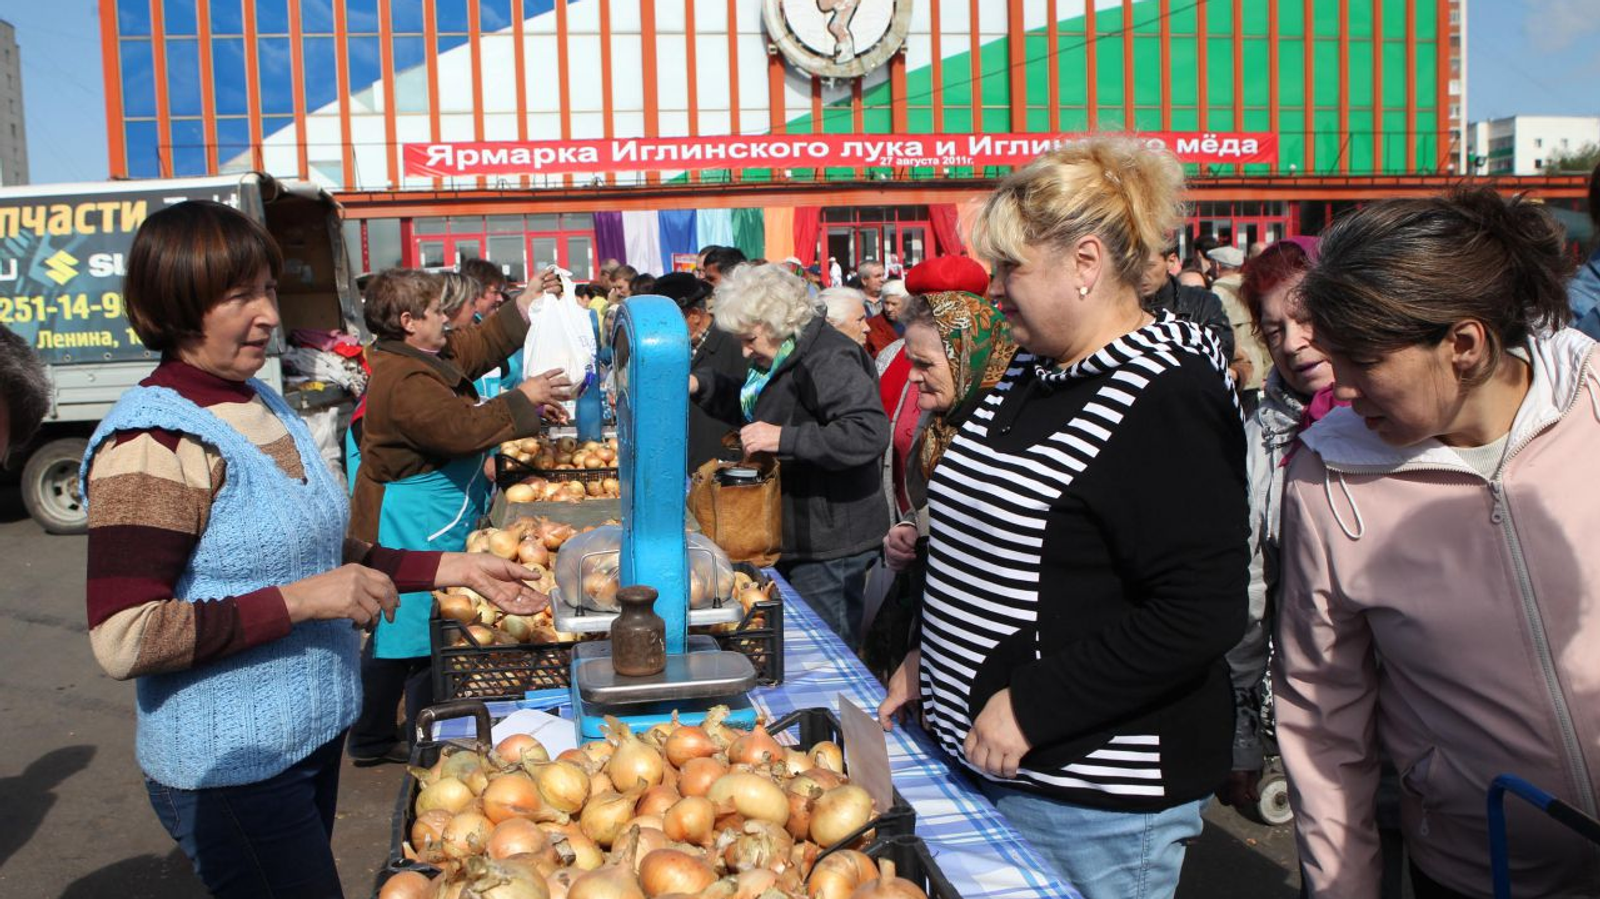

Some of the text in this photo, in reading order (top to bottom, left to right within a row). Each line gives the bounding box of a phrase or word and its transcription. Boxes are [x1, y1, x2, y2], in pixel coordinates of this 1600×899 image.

[425, 145, 598, 171] Ярмарка
[611, 141, 830, 162] Иглинского
[840, 140, 924, 162] лука
[935, 140, 956, 156] и
[1176, 134, 1259, 157] мёда
[880, 156, 974, 167] 27 августа 2011г.
[0, 291, 124, 323] 251-14-9
[37, 329, 119, 349] Ленина,
